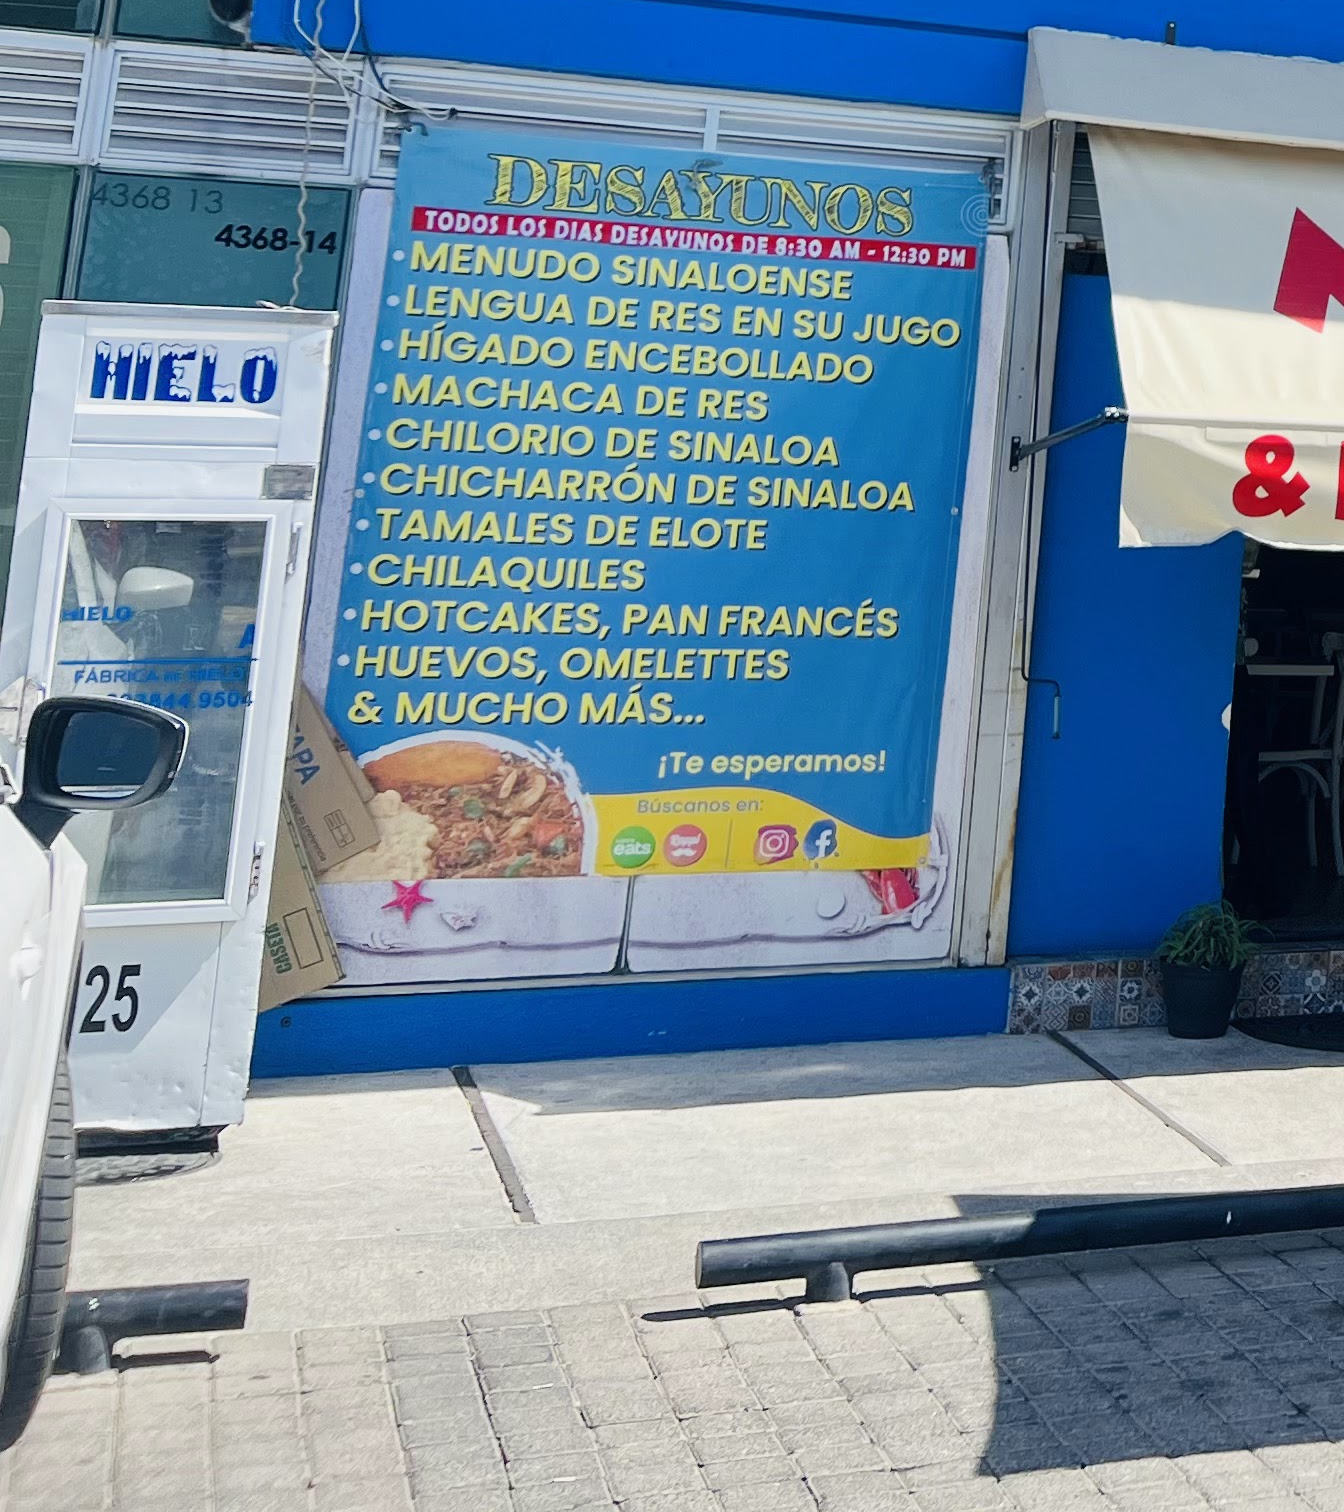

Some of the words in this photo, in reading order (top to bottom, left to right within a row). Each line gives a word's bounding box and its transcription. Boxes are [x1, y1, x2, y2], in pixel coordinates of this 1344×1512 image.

[91, 183, 171, 212] 4368
[483, 153, 914, 236] DESAYUNOS
[214, 224, 338, 255] 4368-14
[425, 210, 498, 234] TODOS
[506, 216, 547, 238] LOS
[553, 220, 603, 242] DIAS
[610, 226, 734, 251] DESAYUNOS
[741, 236, 769, 254] DE
[775, 239, 822, 258] 8:30
[829, 242, 861, 260] AM
[882, 246, 930, 264] 12:30
[937, 248, 967, 267] PM
[410, 241, 601, 283] MENUDO
[611, 255, 853, 300] SINALOENSE
[405, 284, 574, 325] LENGUA
[587, 296, 640, 329] DE
[650, 300, 722, 334] RES
[732, 305, 782, 338] EN
[793, 309, 844, 341] SU
[853, 313, 961, 348] JUGO
[89, 341, 279, 405] HIELO
[398, 322, 574, 369] HÍGADO
[585, 342, 873, 385] ENCEBOLLADO
[391, 374, 622, 416] MACHACA
[636, 390, 686, 419] DE
[698, 392, 768, 422] RES
[386, 419, 594, 458] CHILORIO
[605, 430, 656, 461] DE
[668, 431, 839, 468] SINALOA
[380, 463, 675, 506] CHICHARRÓN
[686, 476, 737, 507] DE
[748, 477, 915, 513] SINALOA
[1233, 435, 1310, 517] &
[376, 509, 573, 547] TAMALES
[586, 516, 638, 549] DE
[649, 519, 767, 551] ELOTE
[367, 554, 646, 592] CHILAQUILES
[361, 599, 610, 639] HOTCAKES,
[623, 605, 709, 637] PAN
[719, 598, 898, 639] FRANCÉS
[354, 645, 548, 684] HUEVOS,
[559, 649, 790, 682] OMELETTES
[348, 694, 383, 725] &
[395, 691, 567, 725] MUCHO
[579, 684, 705, 725] MÁS...
[658, 751, 706, 778] ¡Te
[712, 750, 886, 781] esperamos!
[637, 799, 730, 813] Búscanos
[736, 799, 765, 812] en:
[79, 964, 141, 1034] 25
